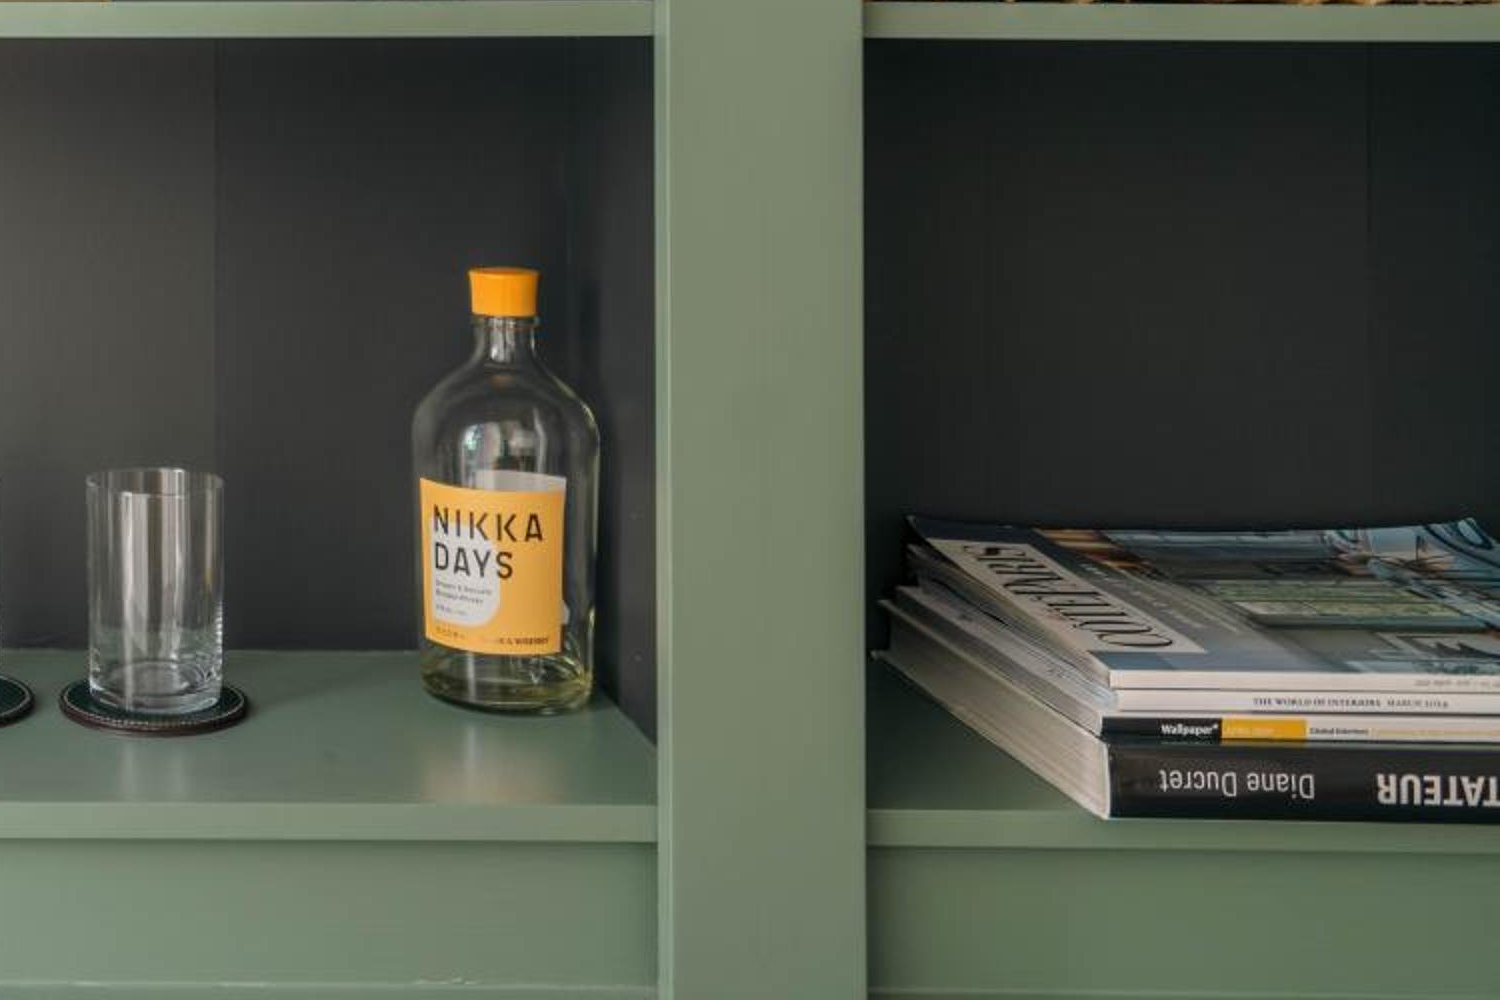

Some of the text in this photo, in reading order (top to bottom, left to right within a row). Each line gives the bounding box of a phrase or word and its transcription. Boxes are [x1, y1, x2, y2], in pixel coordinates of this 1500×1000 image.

[433, 504, 544, 542] NIKKA
[434, 542, 514, 580] DAYS
[1158, 768, 1500, 808] TATEUR Diane Ducret
